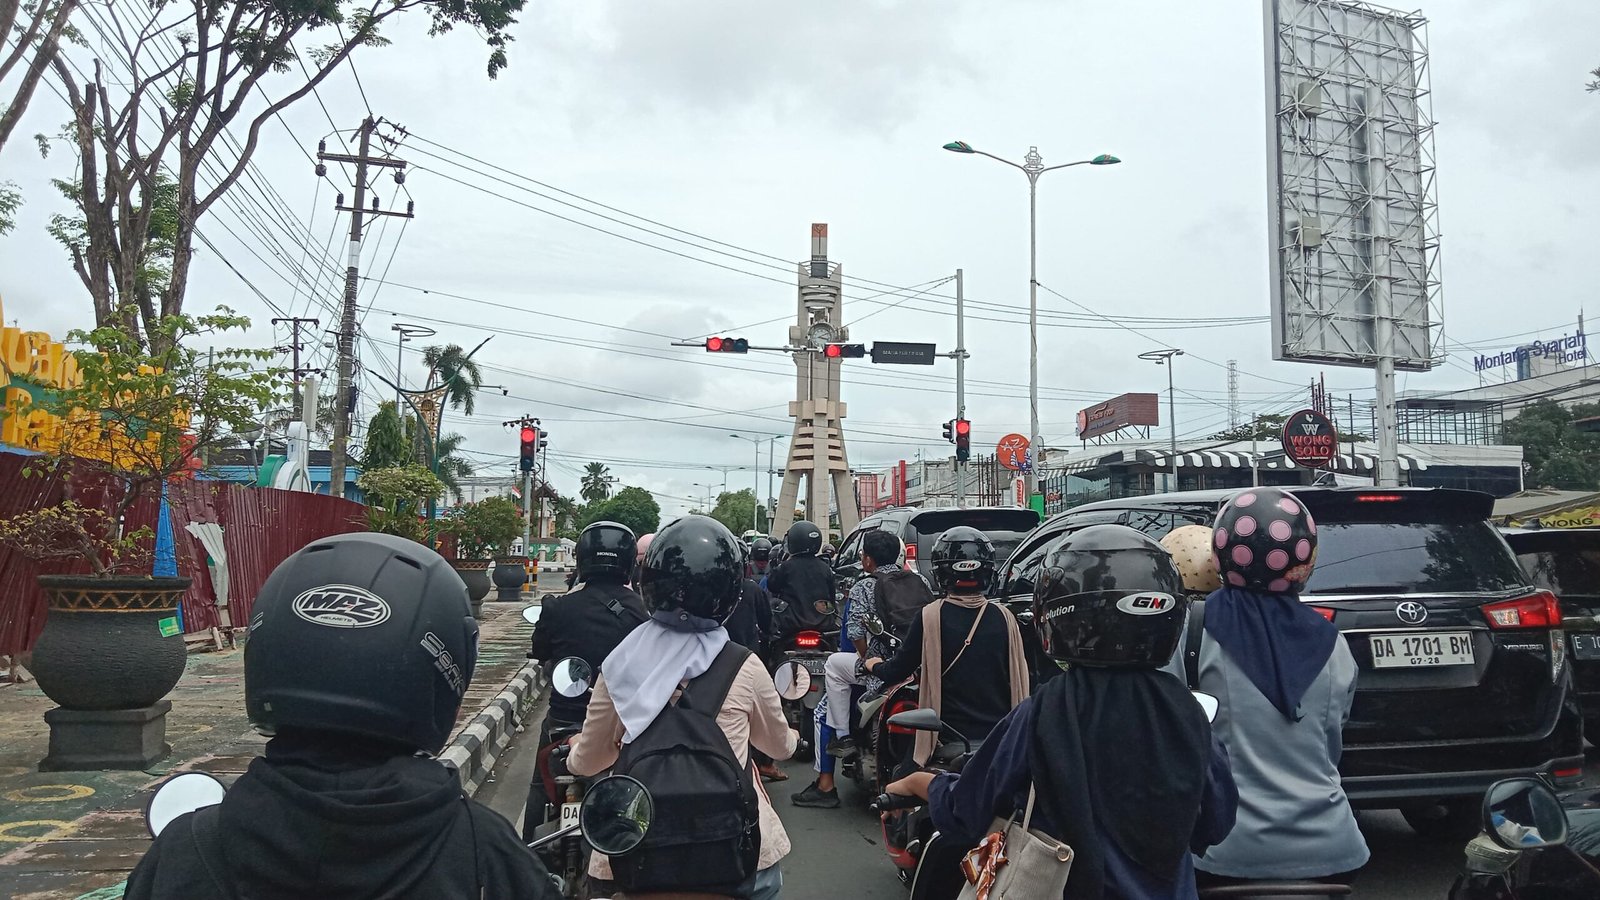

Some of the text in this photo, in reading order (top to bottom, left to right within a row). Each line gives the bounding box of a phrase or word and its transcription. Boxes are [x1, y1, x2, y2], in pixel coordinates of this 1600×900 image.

[1474, 330, 1586, 372] Montana Syariah
[1559, 346, 1587, 364] Hotel
[1290, 435, 1331, 446] WONG
[1295, 446, 1329, 456] SOLO
[1132, 596, 1167, 609] GM
[1040, 604, 1075, 623] eolution
[1373, 636, 1471, 657] DA 1701 BM
[1574, 636, 1583, 649] E
[563, 807, 578, 819] DA
